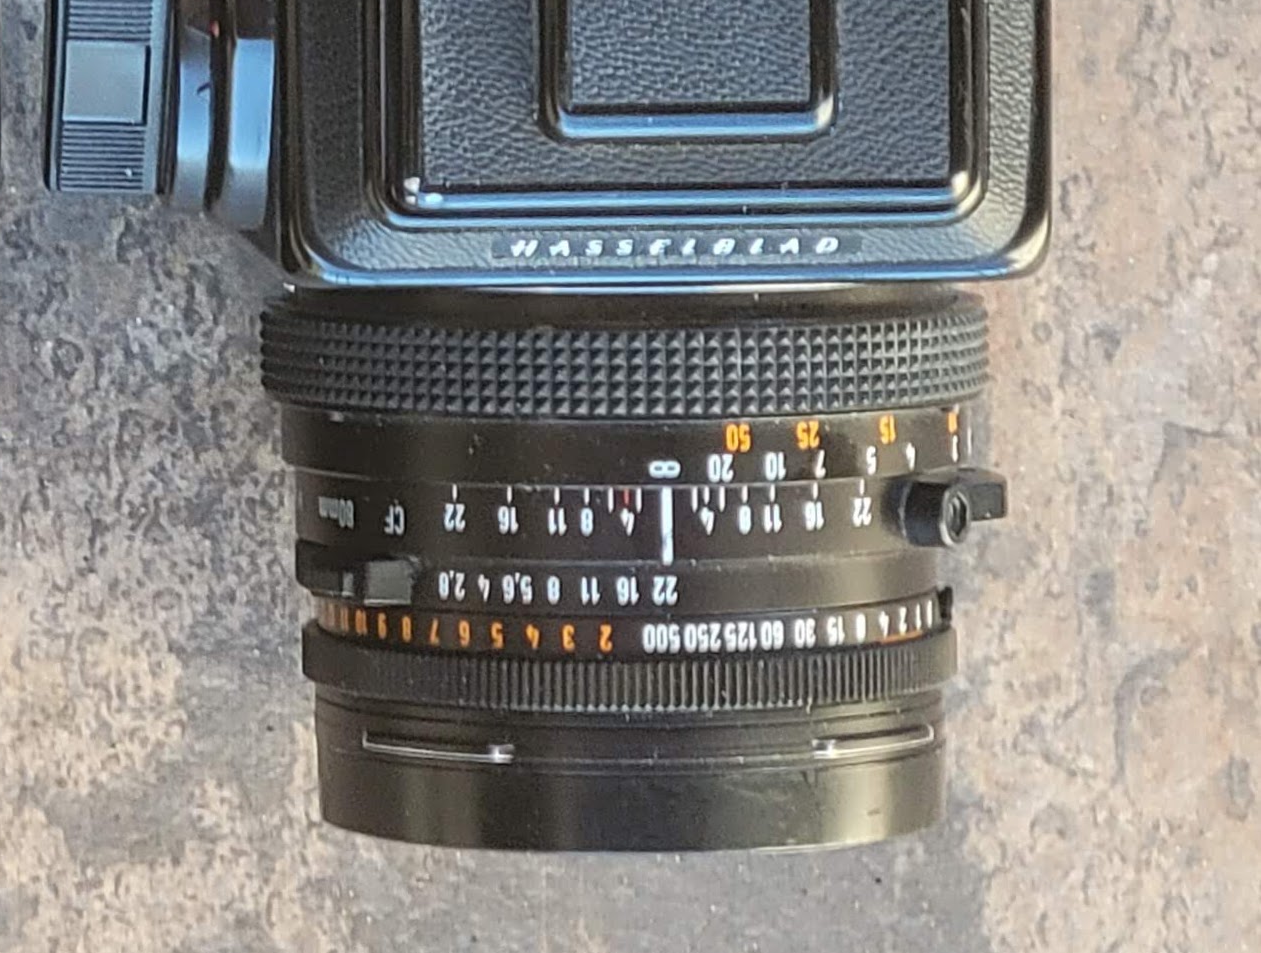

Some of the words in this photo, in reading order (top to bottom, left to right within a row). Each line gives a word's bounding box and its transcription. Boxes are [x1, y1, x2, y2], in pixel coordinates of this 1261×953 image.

[510, 237, 839, 257] HASSELBLAD
[726, 424, 752, 451] 50
[796, 421, 820, 448] 25
[707, 453, 734, 482] 20
[764, 452, 786, 480] 10
[443, 504, 465, 533] 22
[498, 506, 518, 535] 16
[547, 508, 567, 536] 11
[764, 503, 782, 533] 11
[805, 501, 824, 531] 16
[852, 497, 872, 526] 22
[581, 576, 601, 605] 11
[617, 576, 639, 605] 16
[653, 575, 677, 605] 22
[458, 619, 471, 647] 6
[490, 622, 505, 649] 5
[525, 623, 541, 650] 4
[560, 624, 576, 652] 3
[599, 624, 613, 653] 2
[644, 623, 680, 653] 500
[684, 623, 722, 653] 250
[724, 623, 757, 652] 125
[761, 620, 784, 649] 60
[795, 618, 816, 647] 30
